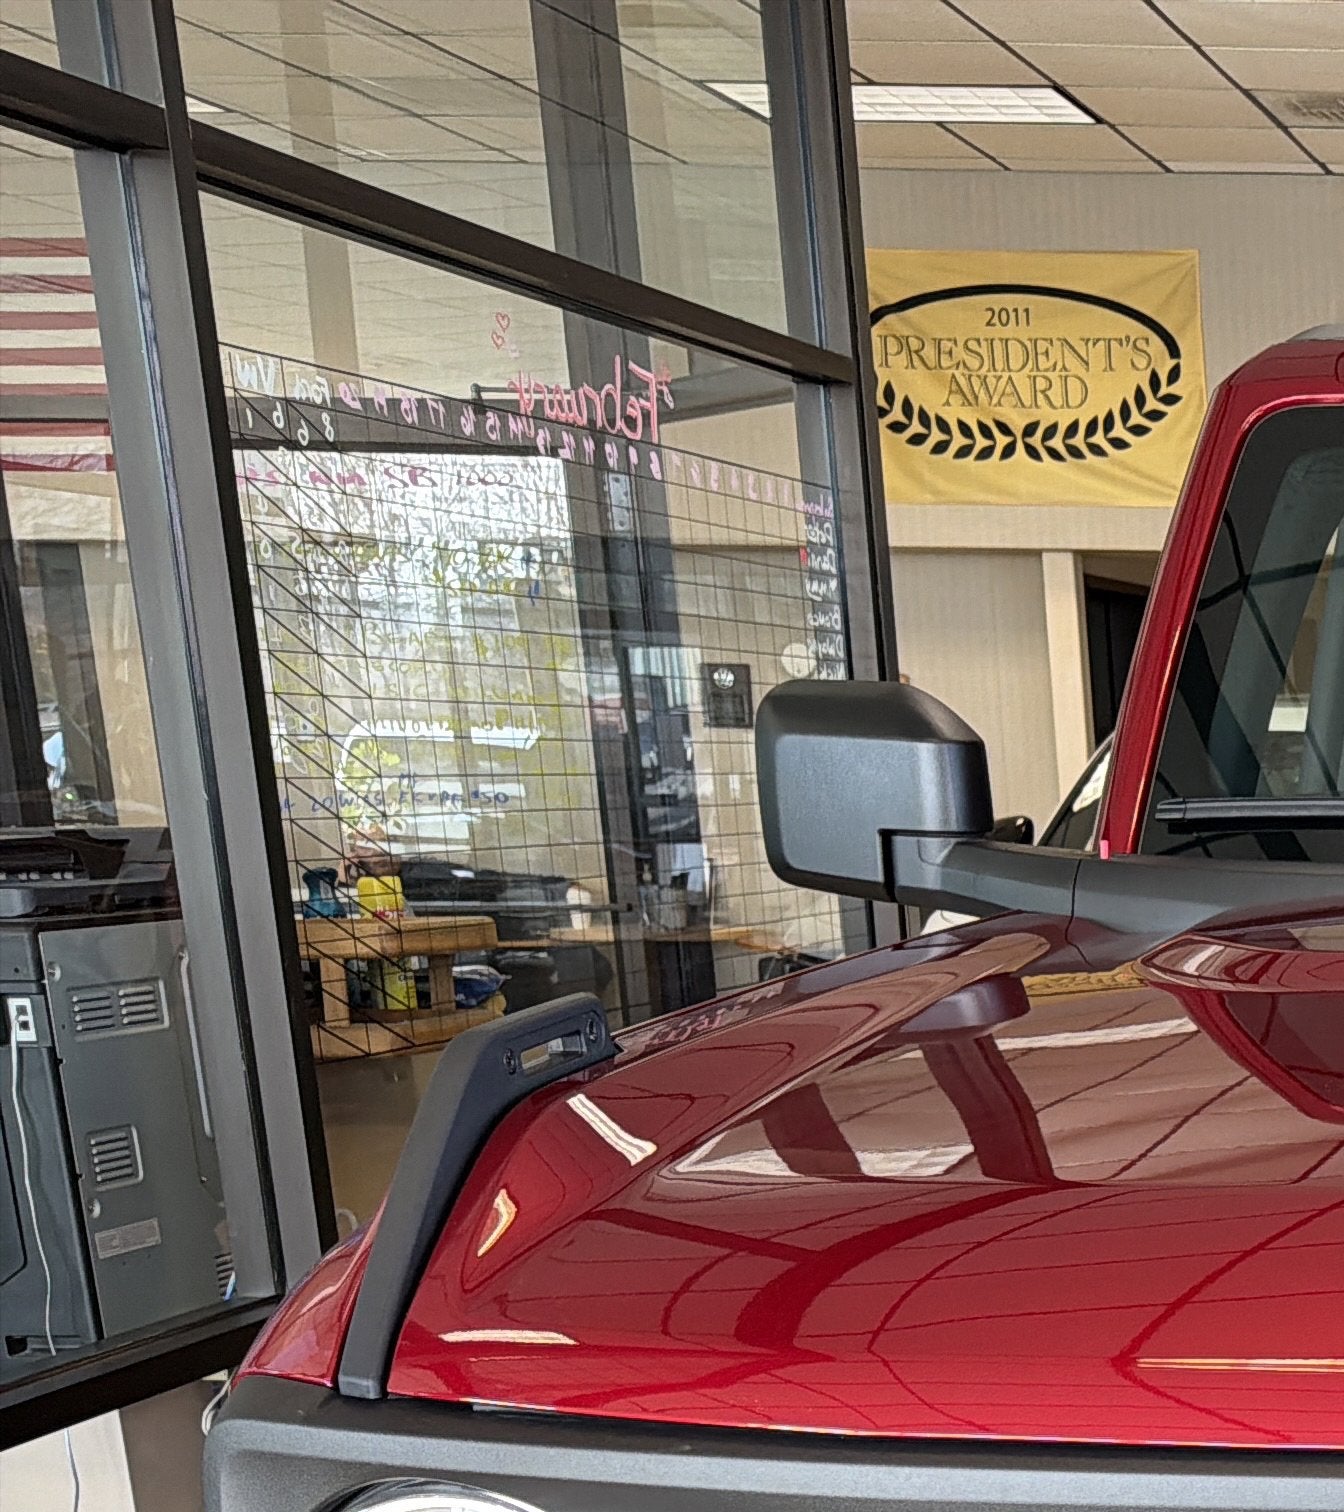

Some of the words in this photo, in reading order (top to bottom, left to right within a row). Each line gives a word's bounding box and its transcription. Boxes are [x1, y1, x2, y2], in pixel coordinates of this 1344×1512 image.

[984, 307, 1031, 327] 2011
[876, 334, 1152, 373] PRESIDENT'S
[942, 372, 1089, 410] AWARD
